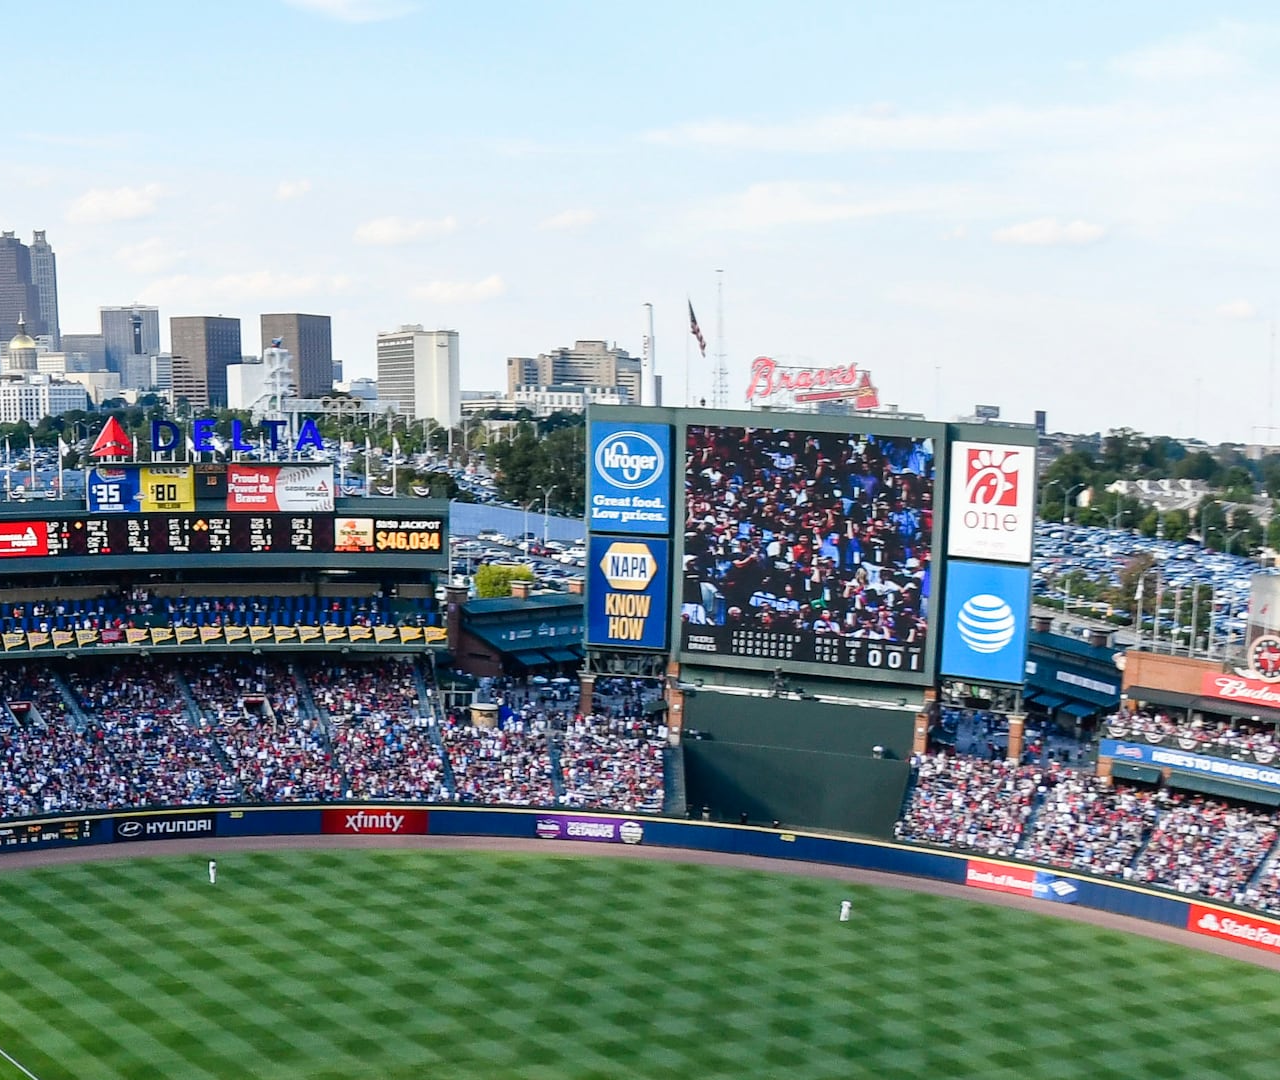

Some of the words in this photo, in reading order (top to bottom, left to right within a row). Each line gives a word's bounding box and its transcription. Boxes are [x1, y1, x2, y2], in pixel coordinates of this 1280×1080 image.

[746, 356, 858, 402] Braves
[151, 418, 324, 452] DELTA
[604, 441, 657, 481] Kroger
[228, 484, 258, 493] Power
[259, 484, 274, 493] the
[232, 474, 259, 483] Proud
[260, 475, 270, 483] to
[92, 484, 120, 503] $35
[151, 484, 177, 501] $80
[236, 494, 267, 503] Braves
[593, 495, 631, 507] Great
[632, 497, 666, 508] food.
[399, 521, 441, 529] JACKPOT
[592, 508, 620, 519] Low
[621, 510, 667, 523] prices.
[964, 510, 1018, 531] one
[376, 531, 440, 551] $46,034
[611, 555, 647, 578] NAPA
[605, 593, 651, 617] KNOW
[608, 616, 645, 640] HOW
[868, 650, 882, 667] 0
[887, 652, 901, 669] 0
[911, 654, 919, 670] 1
[1152, 751, 1193, 767] HERE'S
[1195, 757, 1210, 770] TO
[146, 819, 212, 834] HYUNDAI
[345, 811, 404, 832] xfinity
[967, 869, 993, 882] Bank
[1006, 876, 1048, 893] America
